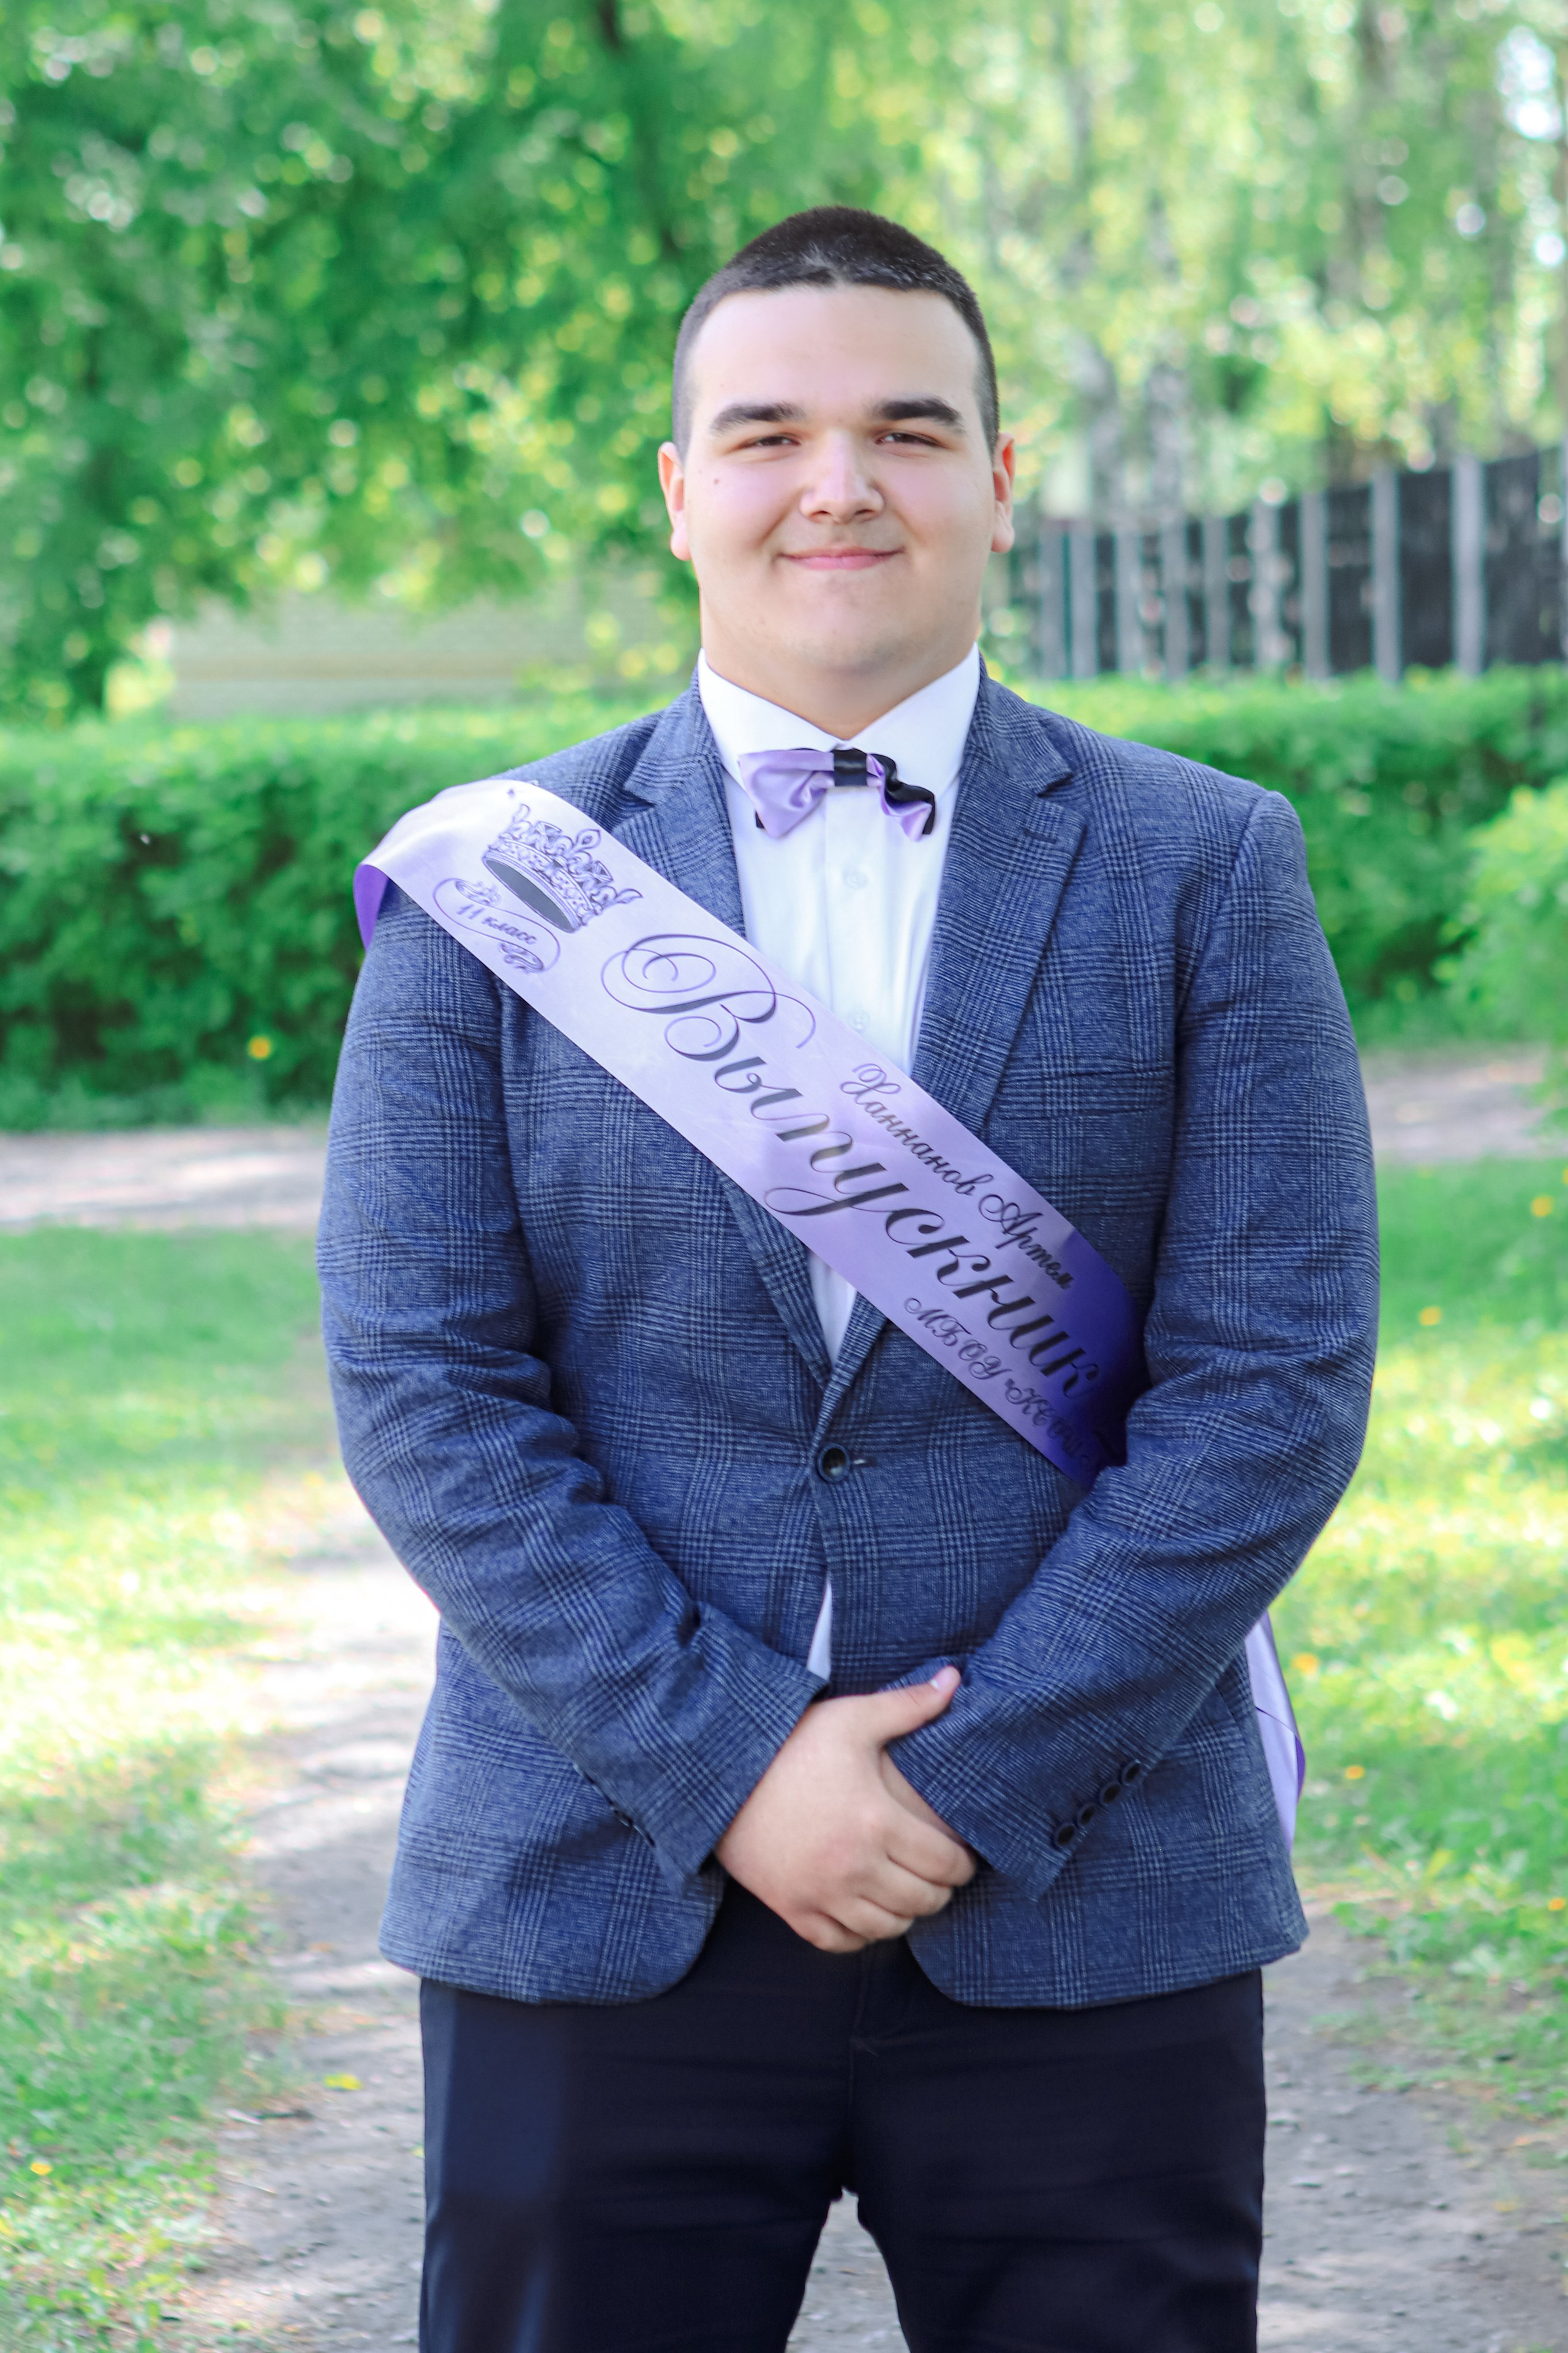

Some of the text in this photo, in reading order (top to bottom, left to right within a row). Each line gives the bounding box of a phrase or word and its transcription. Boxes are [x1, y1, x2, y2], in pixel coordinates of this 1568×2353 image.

[600, 933, 1099, 1399] Выпускник
[840, 1062, 995, 1198] Ханнанов
[903, 1297, 1011, 1380] МБОУ
